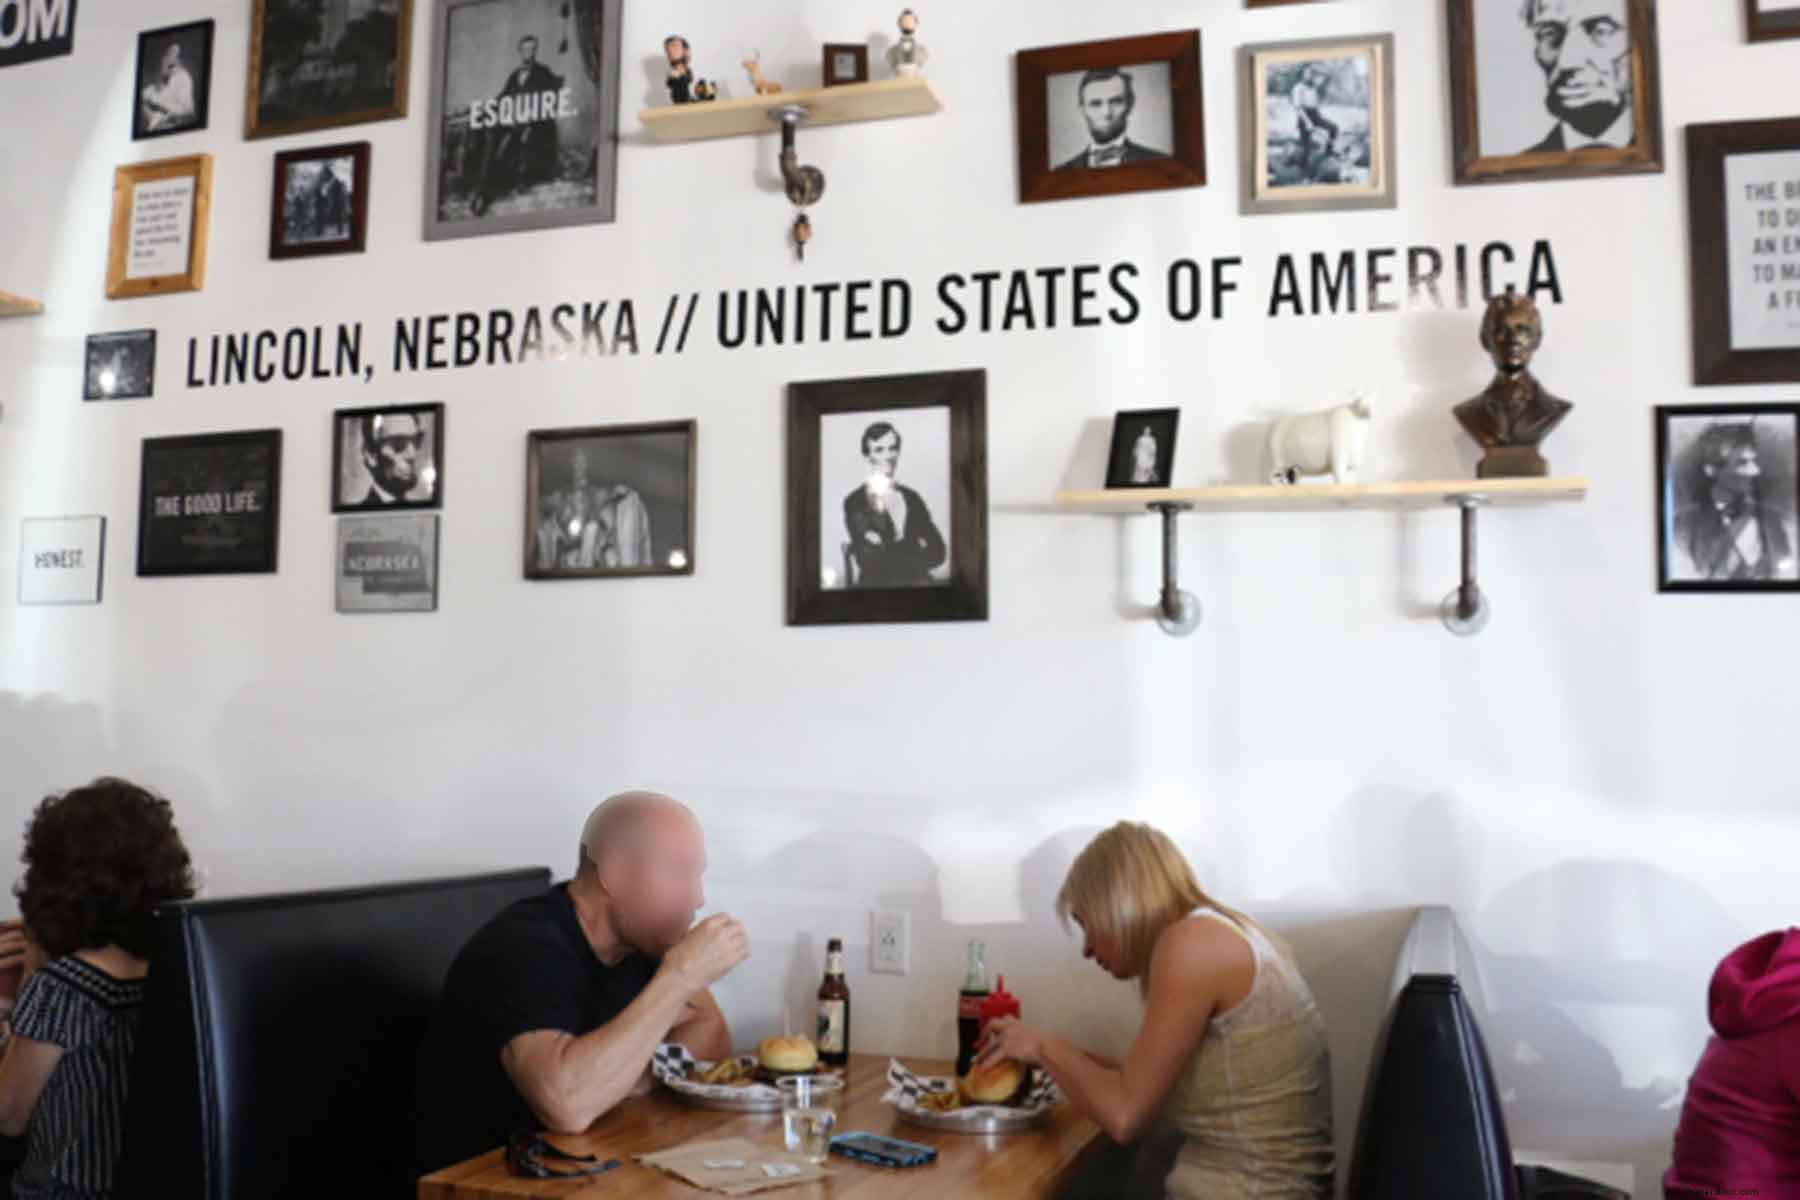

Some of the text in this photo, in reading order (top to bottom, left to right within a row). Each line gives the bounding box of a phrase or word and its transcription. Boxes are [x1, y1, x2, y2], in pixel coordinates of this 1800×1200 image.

[469, 87, 579, 129] ESQUIRE.
[1744, 181, 1776, 200] THE
[1757, 208, 1779, 227] TO
[1752, 237, 1776, 254] AN
[1752, 264, 1774, 282] TO
[1767, 291, 1779, 309] A
[186, 322, 374, 387] LINCOLN,
[393, 299, 639, 371] NEBRASKA
[717, 277, 911, 348] UNITED
[936, 262, 1140, 335] STATES
[1167, 256, 1242, 321] OF
[1268, 240, 1563, 317] AMERICA
[154, 496, 180, 515] THE
[184, 493, 222, 514] GOOD
